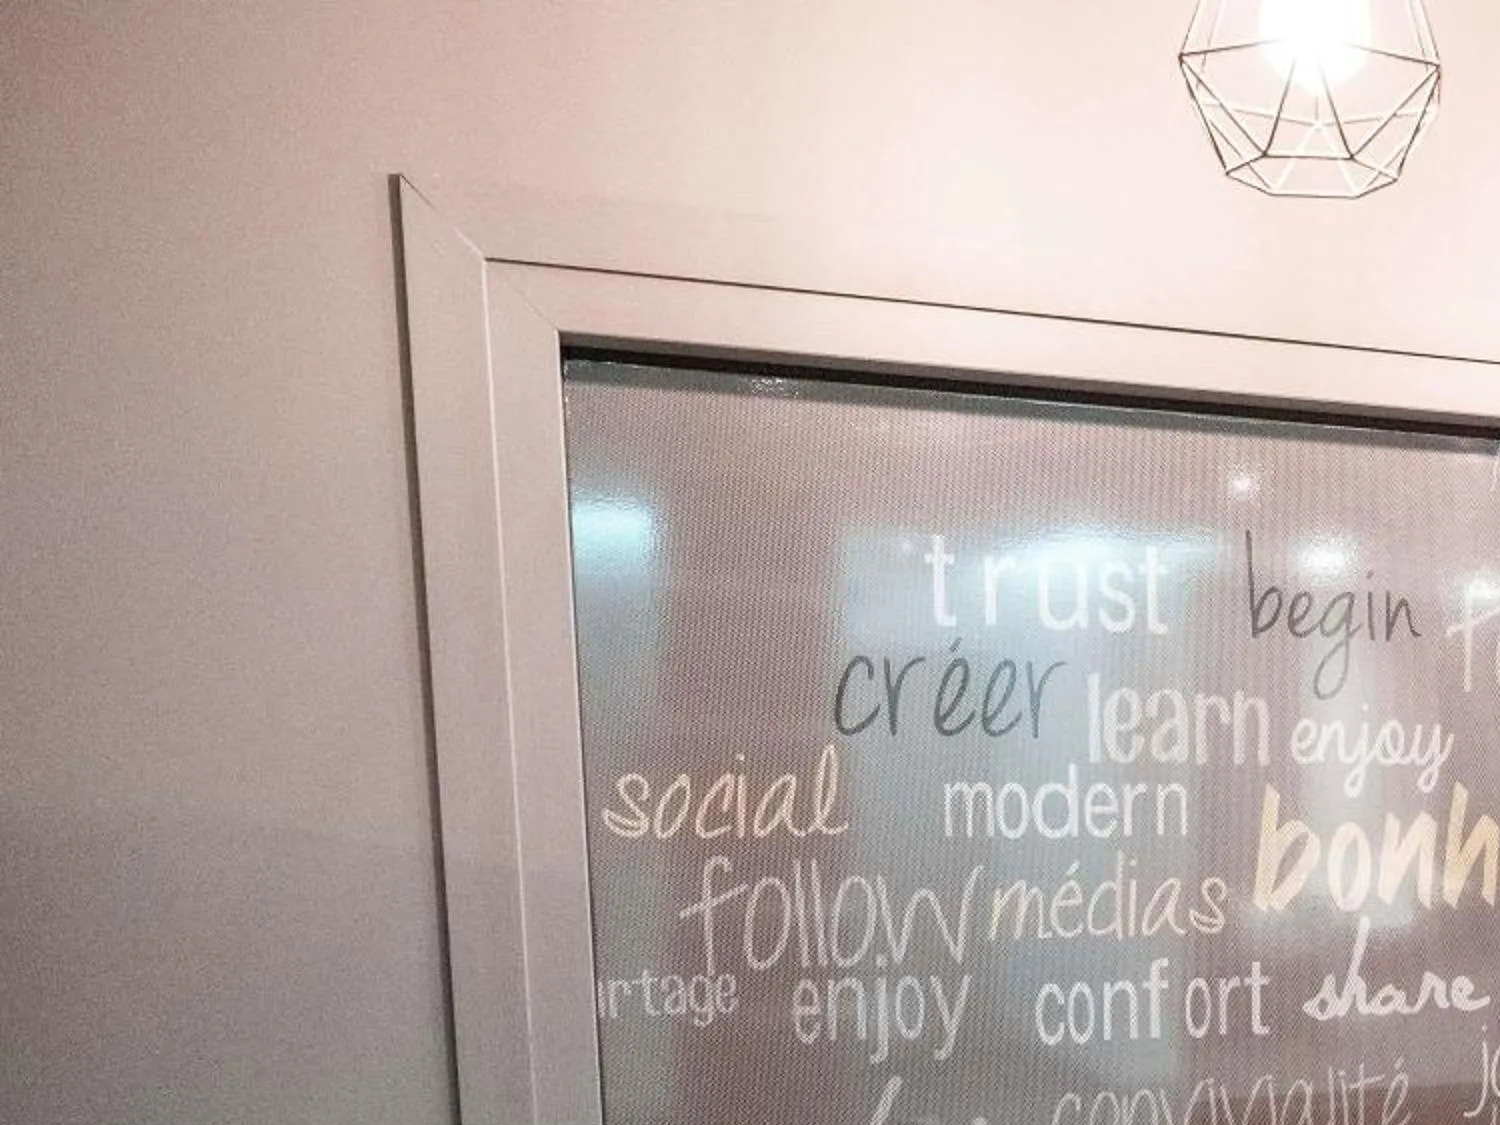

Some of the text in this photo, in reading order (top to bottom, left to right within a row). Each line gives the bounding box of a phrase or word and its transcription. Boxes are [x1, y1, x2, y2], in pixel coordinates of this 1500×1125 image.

[925, 535, 1168, 635] trust
[1245, 530, 1420, 700] begin
[833, 637, 1066, 738] créer
[1087, 672, 1270, 767] learn
[603, 744, 848, 840] social
[1291, 705, 1454, 797] enjoy
[944, 764, 1187, 838] modern
[679, 854, 984, 976] follow
[989, 849, 1228, 940] médias
[598, 969, 738, 1026] rtage
[792, 955, 971, 1062] enjoy
[1036, 958, 1270, 1046] confort
[1303, 916, 1490, 1021] share
